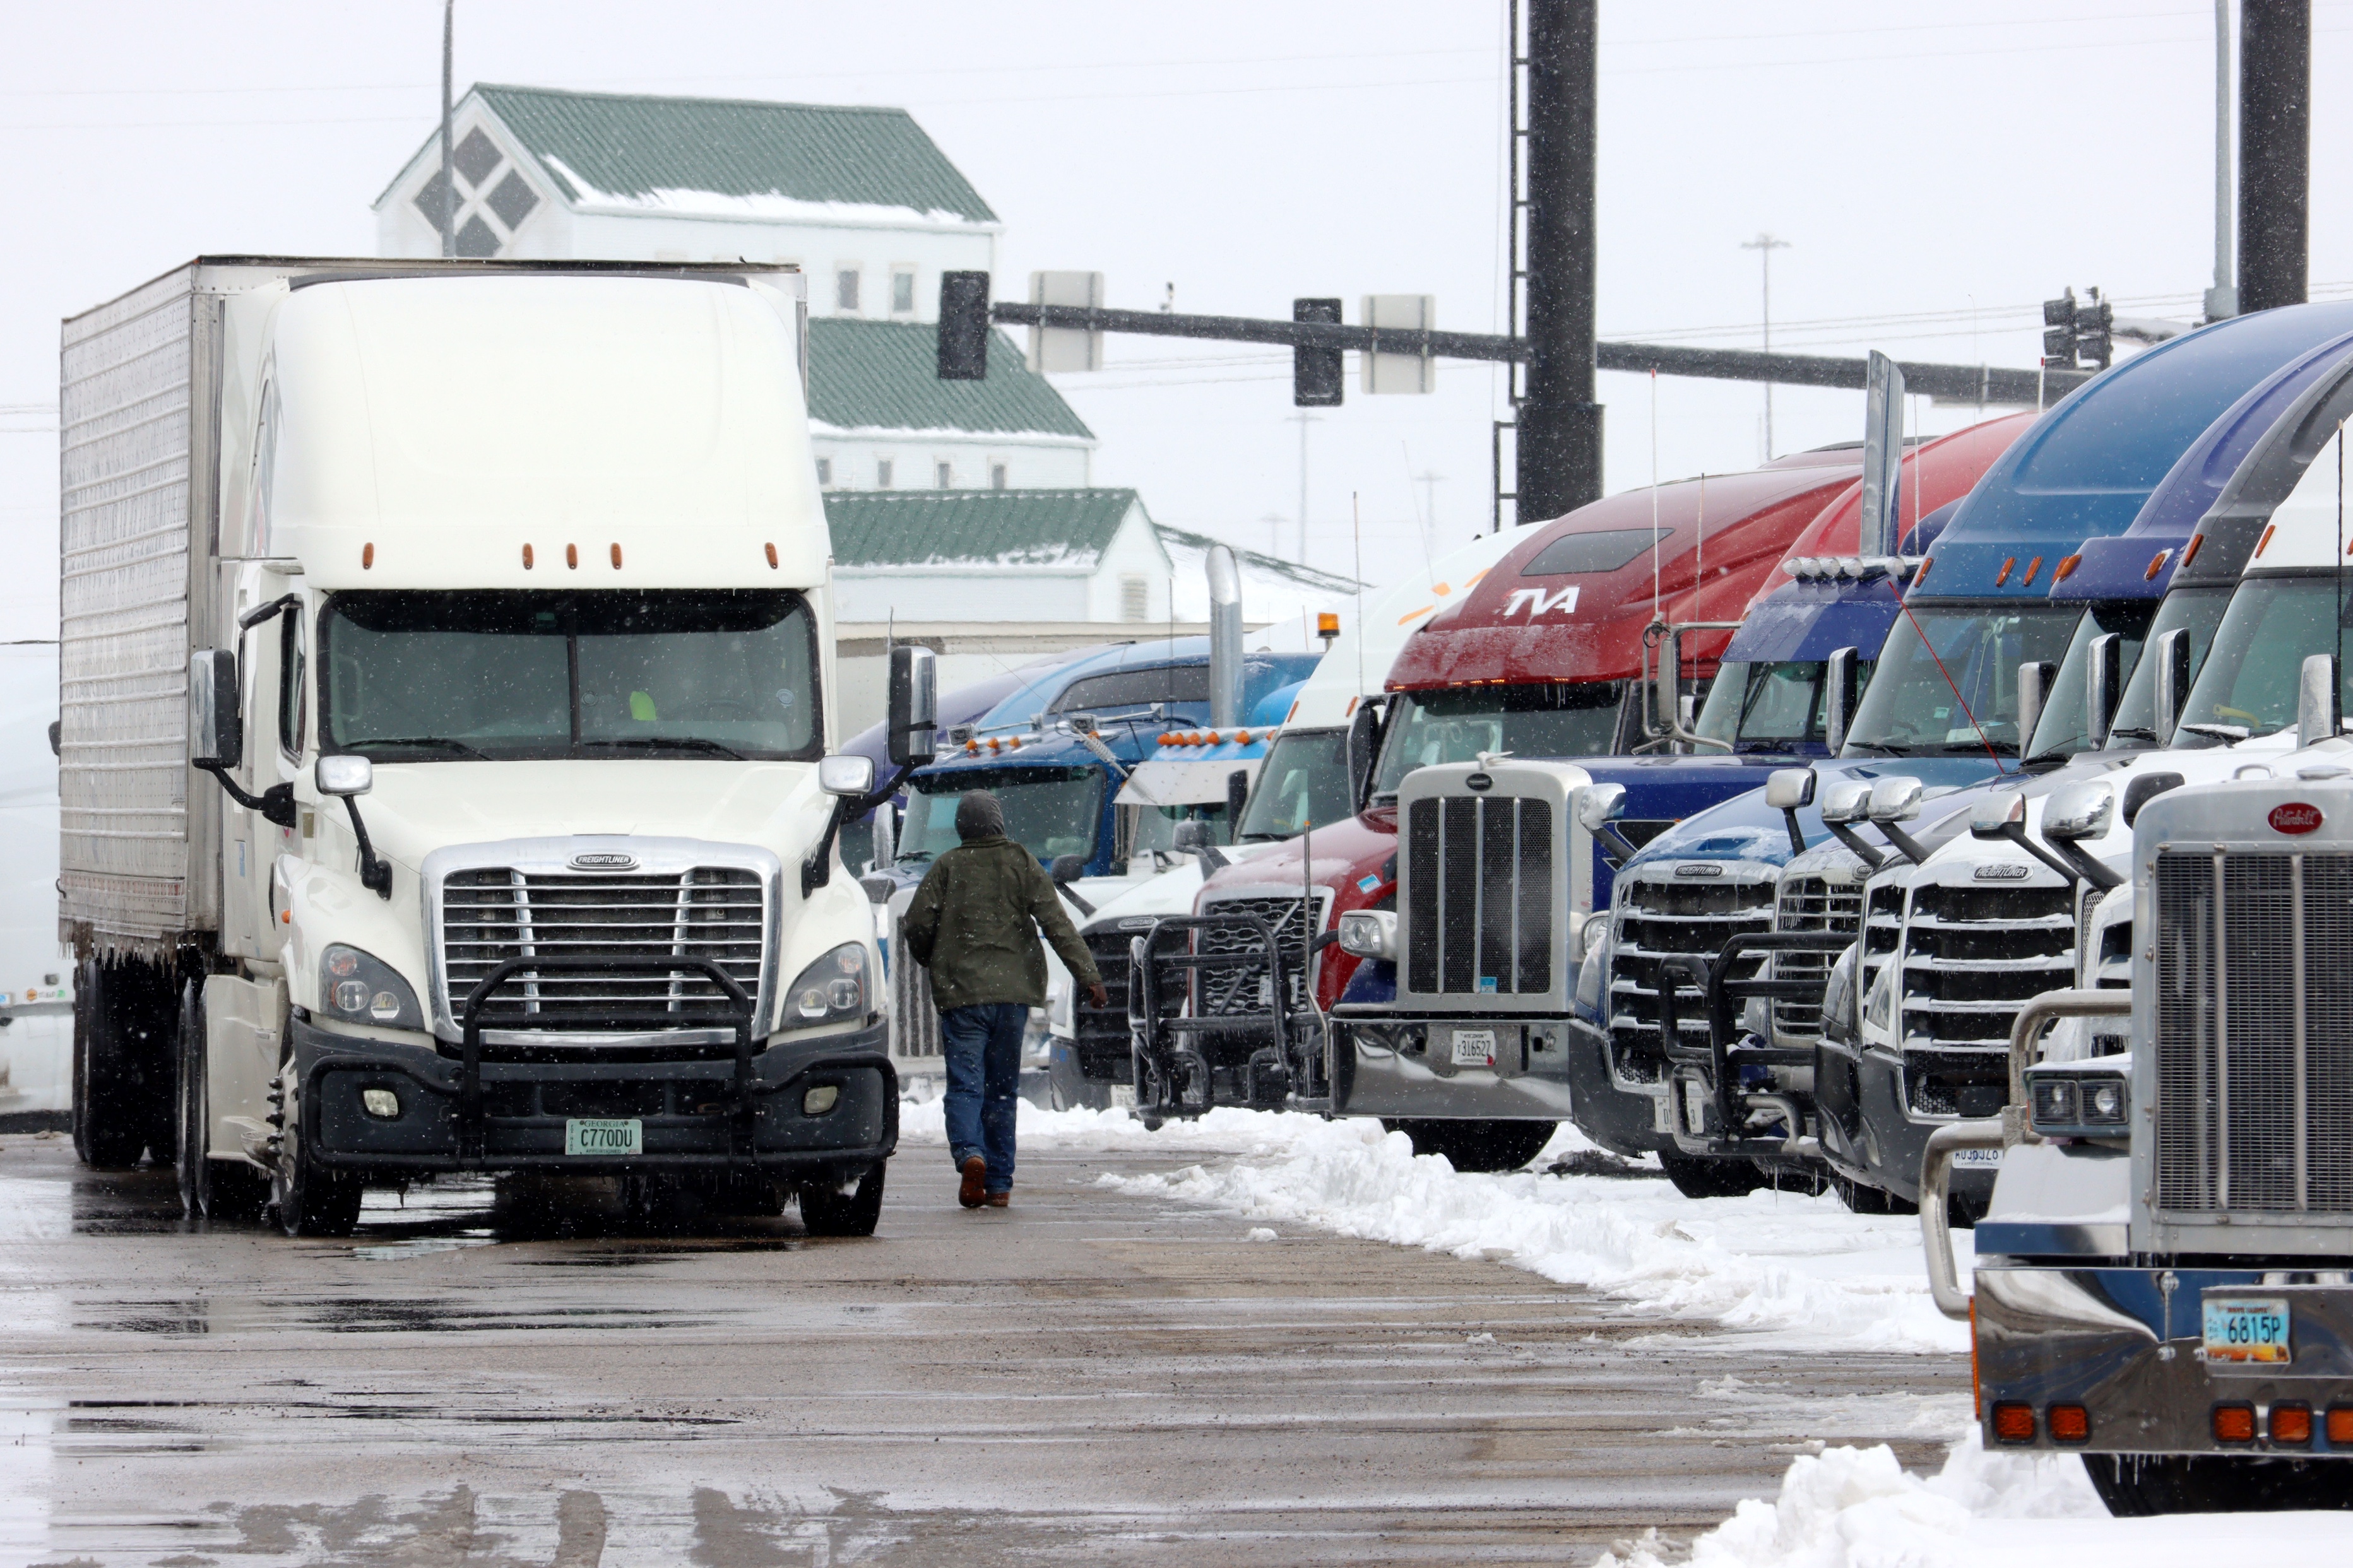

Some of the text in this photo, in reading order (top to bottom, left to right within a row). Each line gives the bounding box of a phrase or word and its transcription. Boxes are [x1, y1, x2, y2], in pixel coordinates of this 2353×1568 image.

[1503, 586, 1580, 616] TVA
[578, 856, 629, 864] FREIGHTLINER
[1676, 866, 1722, 875] FREIGHTLINER
[1975, 866, 2027, 877] FREIGHTLINER
[581, 1129, 632, 1147] C770DU
[2228, 1316, 2280, 1343] 6815P
